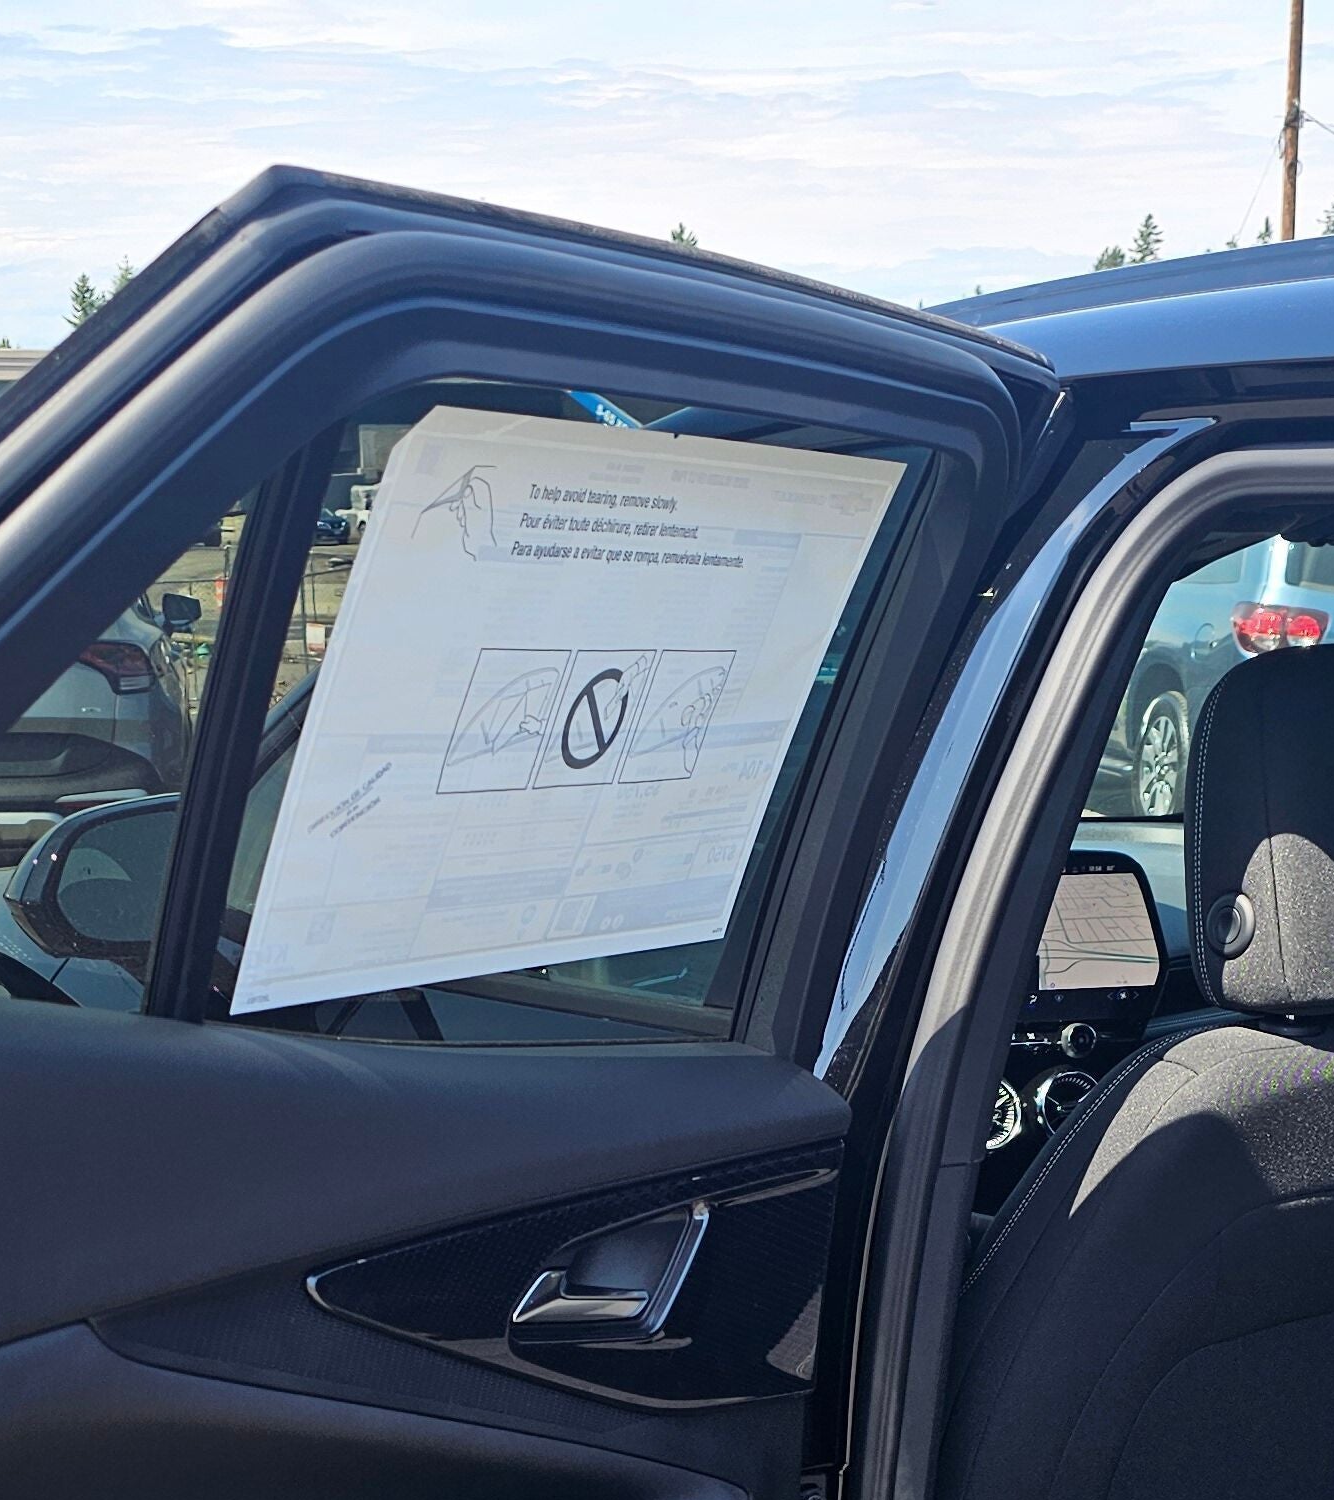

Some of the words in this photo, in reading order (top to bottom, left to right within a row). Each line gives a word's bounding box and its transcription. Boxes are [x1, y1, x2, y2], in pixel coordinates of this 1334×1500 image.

[529, 483, 541, 500] To
[541, 485, 562, 504] help
[562, 488, 588, 504] avoid
[586, 489, 618, 509] tearing,
[619, 494, 651, 508] remove
[650, 495, 679, 513] slowly.
[519, 512, 542, 529] Pour
[542, 513, 568, 531] éviter
[568, 516, 591, 532] toute
[591, 517, 631, 537] déchirure,
[633, 521, 660, 537] retirer
[510, 540, 533, 556] Para
[533, 542, 573, 560] ayudarse
[572, 547, 580, 559] a
[580, 545, 606, 561] evitar
[606, 549, 623, 564] que
[622, 550, 634, 562] se
[633, 550, 660, 566] rompa,
